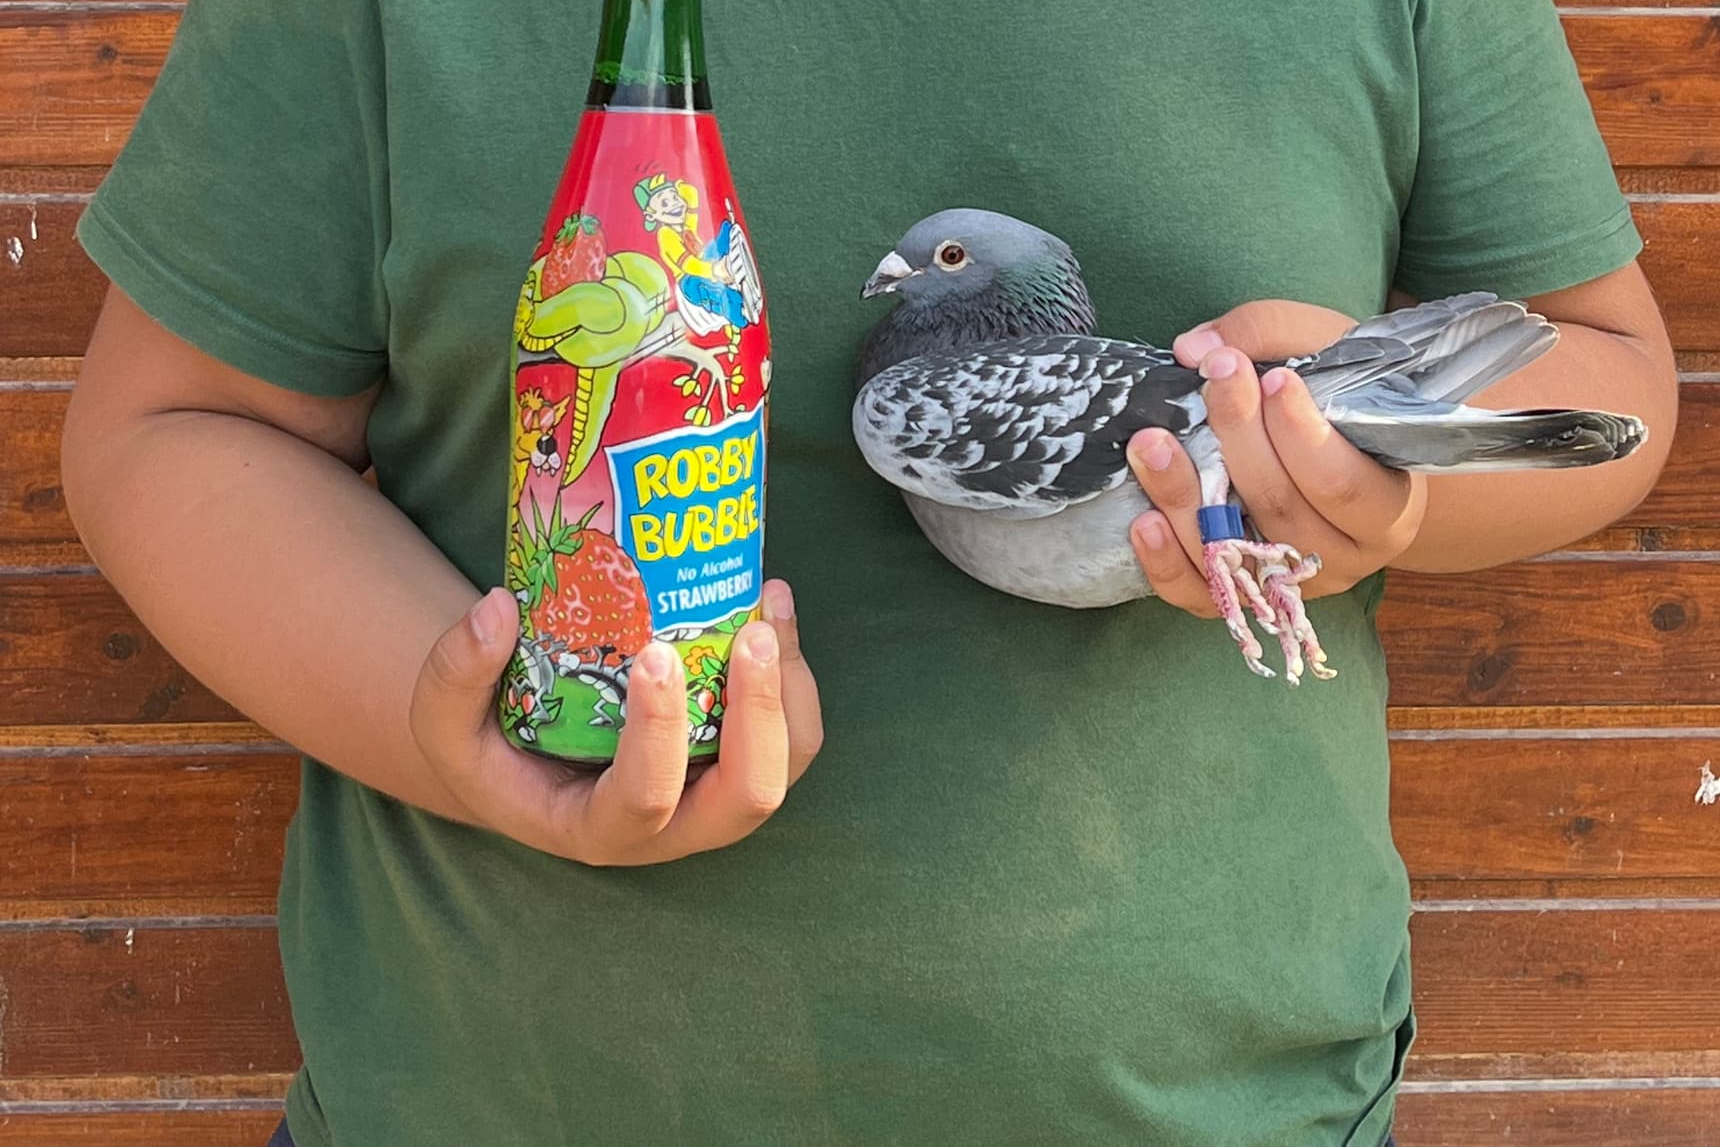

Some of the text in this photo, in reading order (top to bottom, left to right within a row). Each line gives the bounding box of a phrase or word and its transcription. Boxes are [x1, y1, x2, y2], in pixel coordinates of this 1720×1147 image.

[633, 430, 758, 508] ROBBY
[629, 484, 759, 561] BUBBLE
[657, 570, 753, 614] STRAWBERRY
[676, 554, 744, 583] No Alcohol
